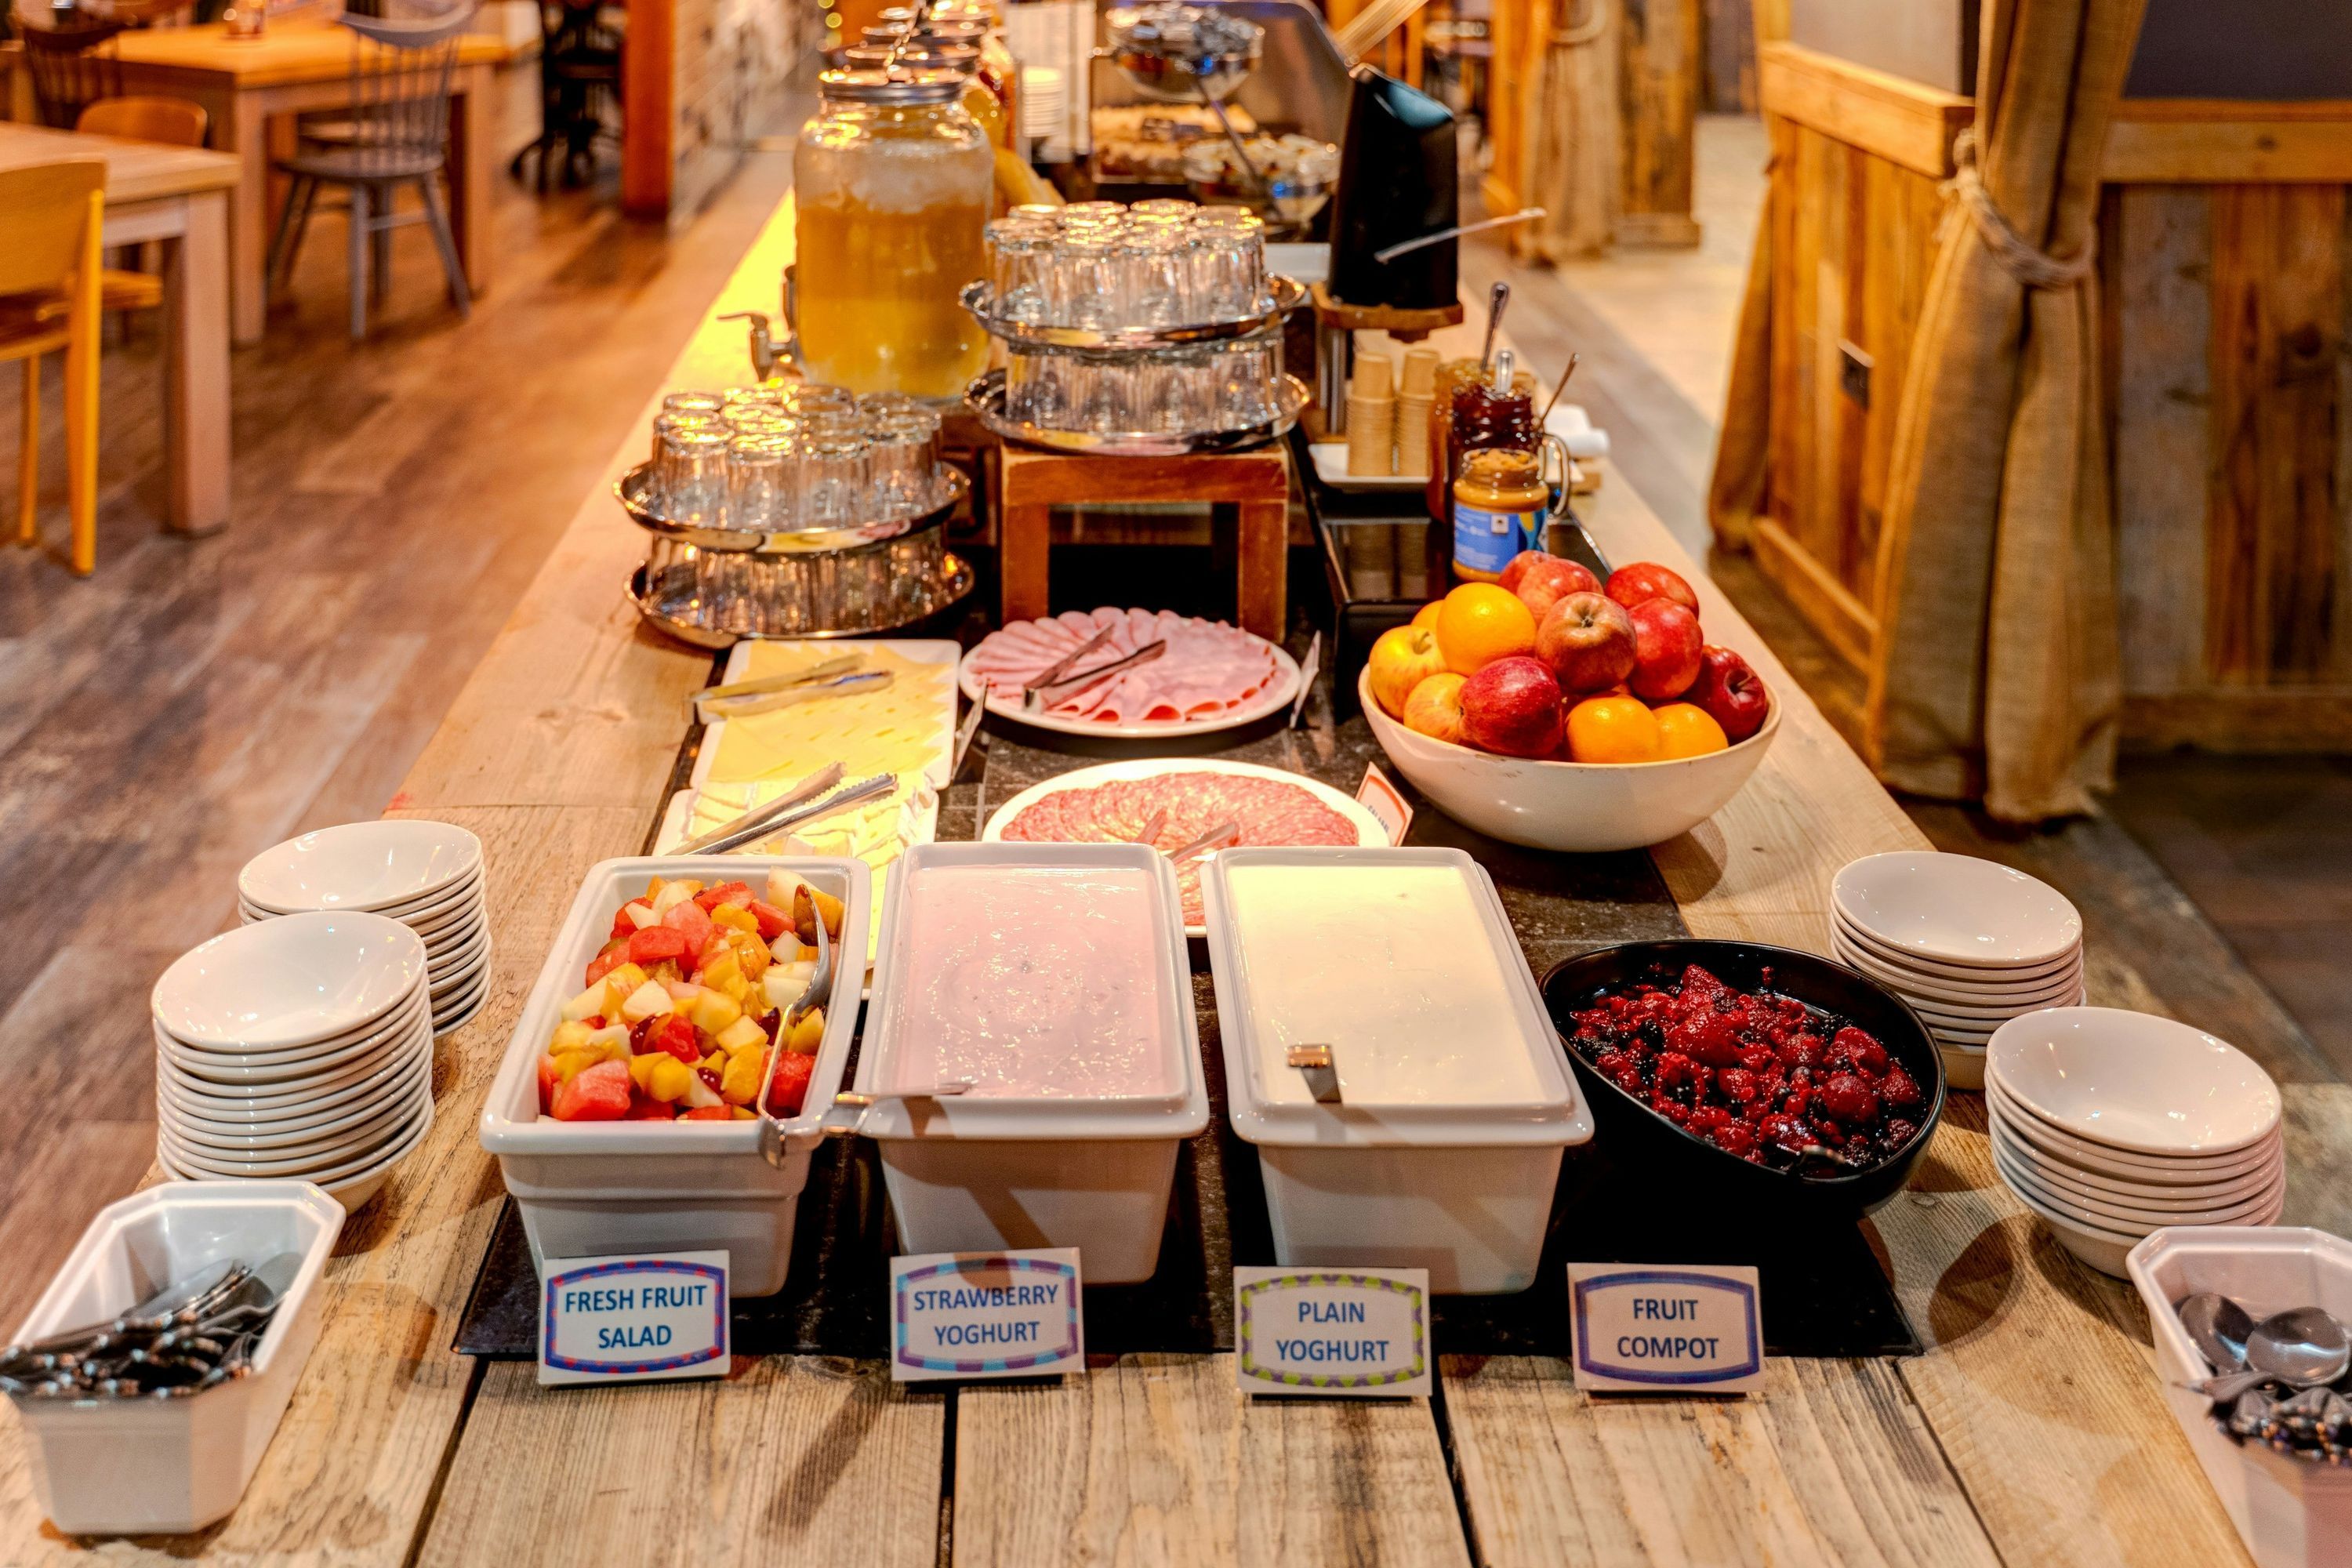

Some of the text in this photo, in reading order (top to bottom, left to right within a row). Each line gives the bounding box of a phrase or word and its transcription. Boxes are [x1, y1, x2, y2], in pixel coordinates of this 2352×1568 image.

[565, 1285, 707, 1313] FRESH FRUIT
[913, 1284, 1058, 1312] STRAWBERRY
[1633, 1298, 1698, 1321] FRUIT
[1298, 1301, 1365, 1323] PLAIN
[598, 1324, 672, 1349] SALAD
[934, 1321, 1040, 1346] YOGHURT
[1276, 1339, 1389, 1362] YOGHURT
[1617, 1336, 1719, 1359] COMPOT
